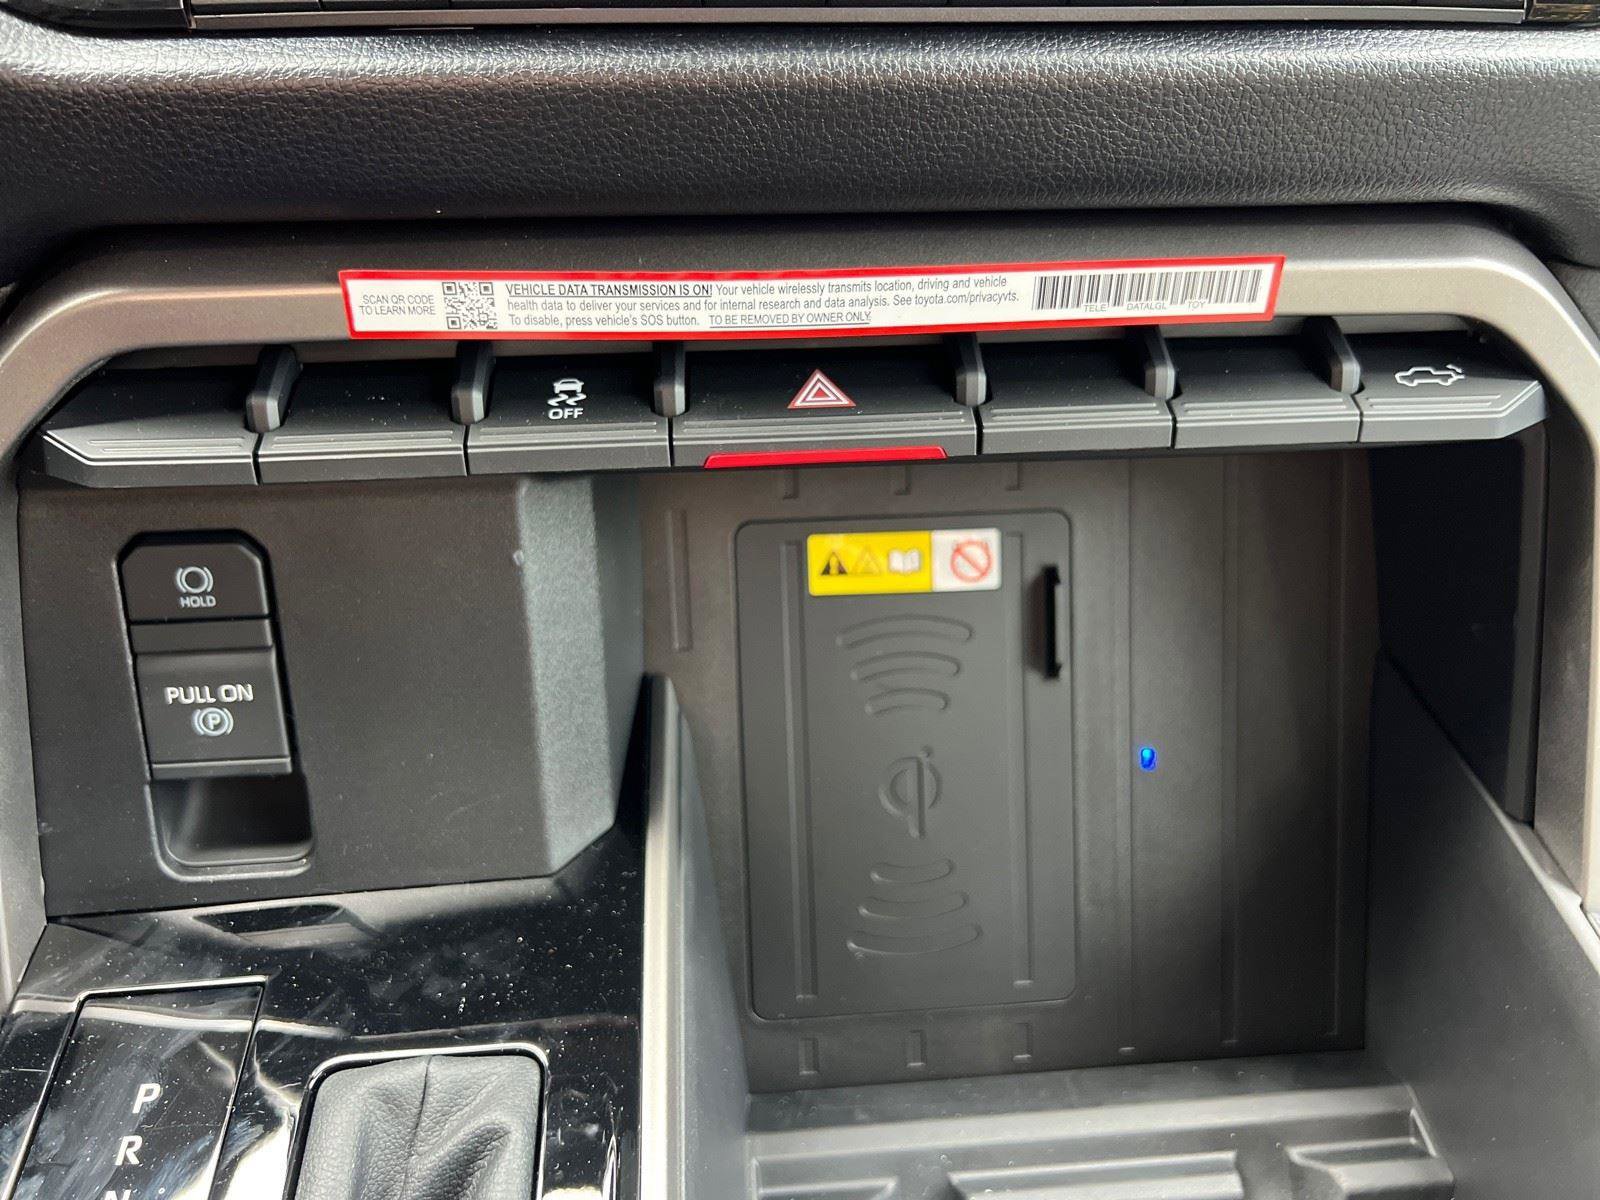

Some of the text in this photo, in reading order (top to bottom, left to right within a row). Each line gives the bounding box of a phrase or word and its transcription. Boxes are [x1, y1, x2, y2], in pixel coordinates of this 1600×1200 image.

[505, 275, 1007, 297] VEHICLE DATA TRANSMISSION IS ON! Your vehicle wirelessly transmits location, driving and vehicle
[362, 294, 434, 304] SCAN QR CODE
[507, 299, 539, 311] health
[541, 299, 563, 311] data
[566, 300, 576, 311] to
[579, 300, 613, 311] deliver
[615, 301, 638, 313] your
[640, 300, 680, 311] services
[683, 299, 701, 311] and
[704, 299, 717, 311] for
[720, 299, 756, 310] internal
[759, 298, 801, 310] research
[803, 297, 822, 309] and
[824, 297, 846, 309] data
[848, 295, 890, 309] analysis.
[893, 294, 912, 306] See
[360, 305, 436, 315] TO LEARN MORE
[1084, 304, 1107, 312] TELE
[509, 314, 521, 325] To
[524, 314, 563, 327] disable,
[565, 316, 593, 329] press
[595, 314, 638, 326] vehicle's
[640, 314, 664, 326] SOS
[666, 314, 700, 326] button.
[709, 314, 723, 325] TO
[725, 314, 738, 325] BE
[740, 313, 790, 324] REMOVED
[791, 313, 805, 323] BY
[806, 312, 844, 323] OWNER
[548, 407, 584, 420] OFF
[180, 596, 217, 608] HOLD
[164, 683, 254, 704] PULL ON
[207, 712, 221, 730] P
[132, 1083, 161, 1114] P
[115, 1135, 143, 1166] R
